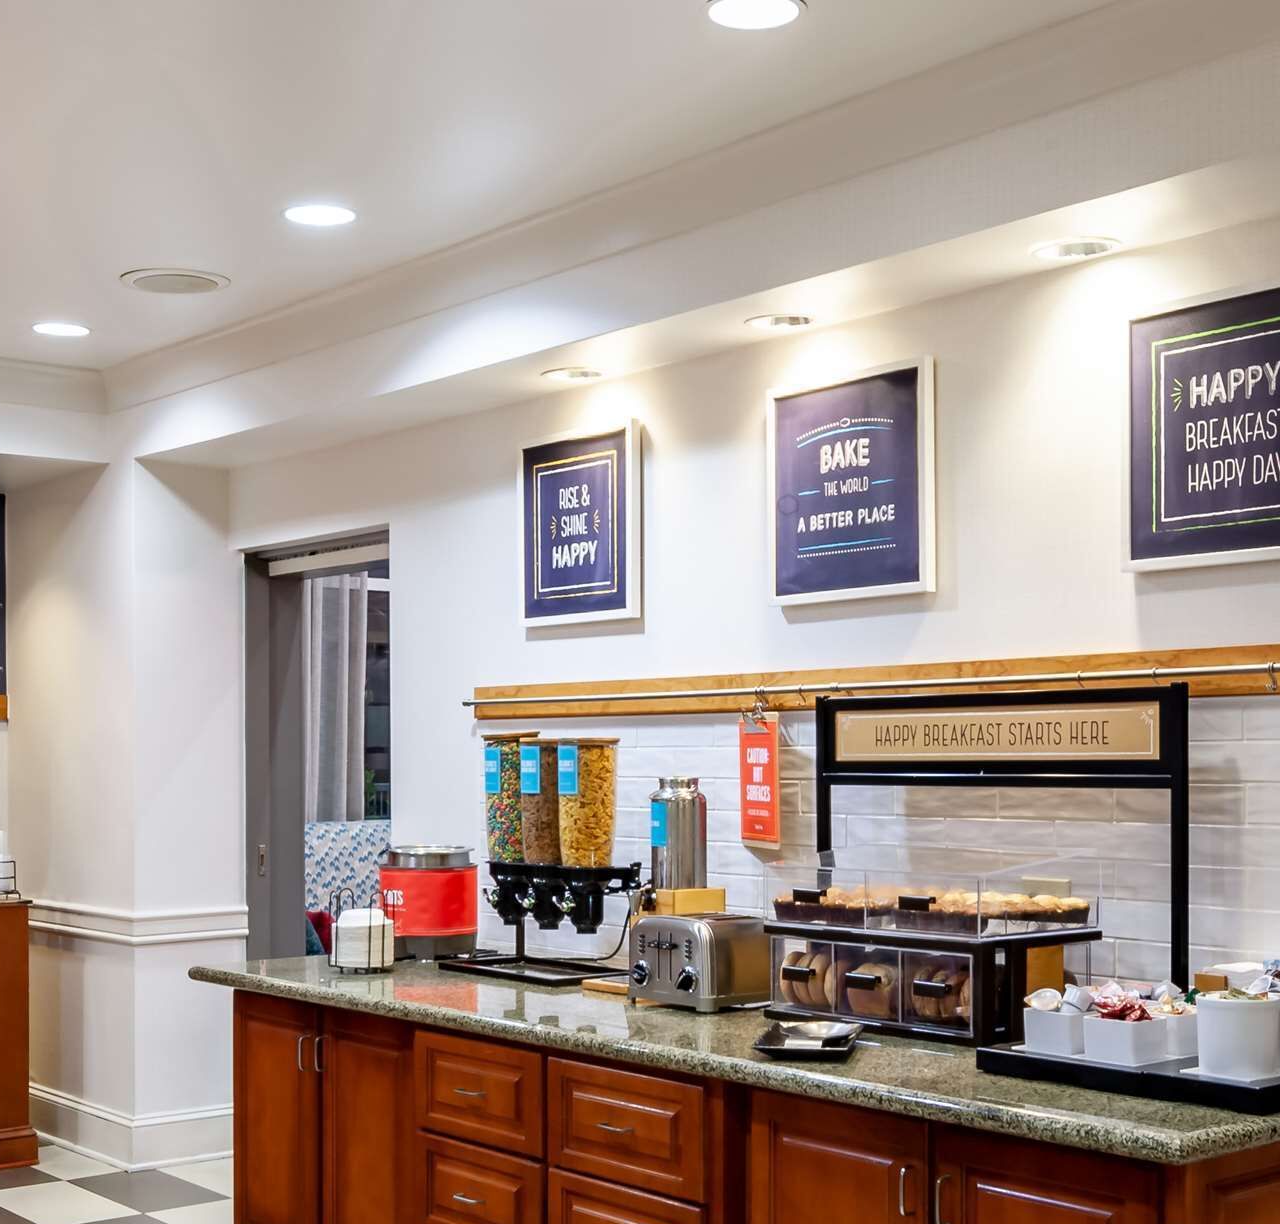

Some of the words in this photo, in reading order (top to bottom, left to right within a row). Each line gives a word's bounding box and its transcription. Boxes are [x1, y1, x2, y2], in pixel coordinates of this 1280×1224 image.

[820, 438, 870, 474] BAKE
[823, 481, 838, 496] THE
[840, 476, 869, 494] WORLD
[1188, 457, 1246, 494] HAPPY
[559, 486, 580, 510] RISE
[581, 484, 590, 507] &
[561, 512, 588, 538] SHINE
[797, 517, 806, 533] A
[809, 510, 854, 532] BETTER
[858, 504, 896, 525] PLACE
[552, 540, 598, 569] HAPPY
[875, 725, 918, 747] HAPPY
[924, 723, 1002, 747] BREAKFAST
[1008, 722, 1062, 746] STARTS
[1070, 721, 1110, 745] HERE
